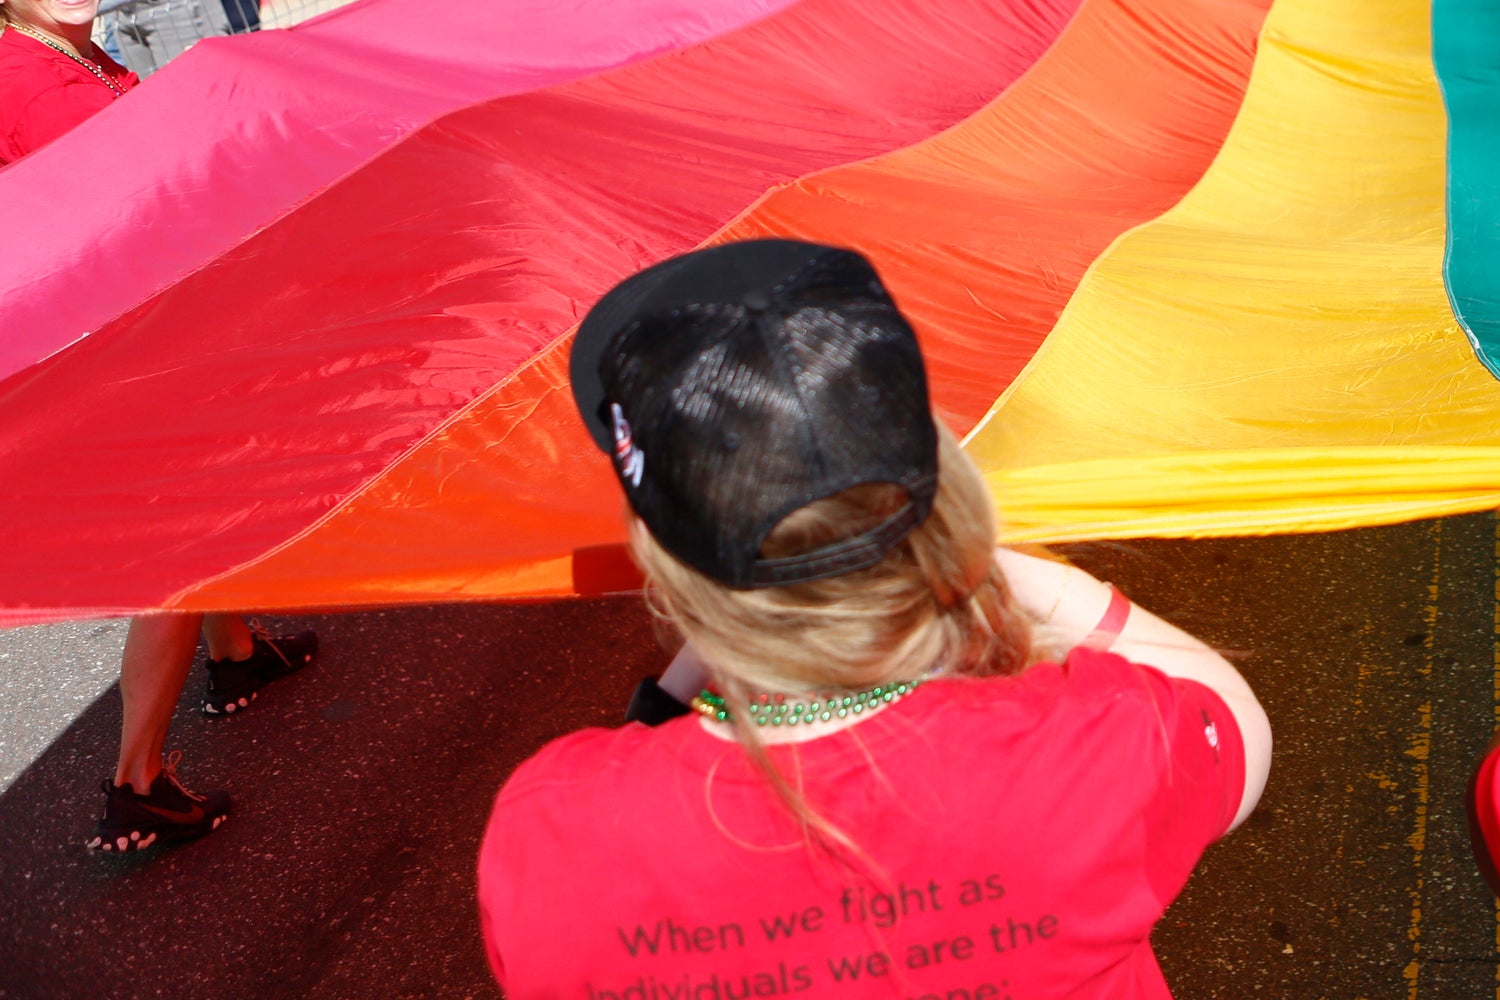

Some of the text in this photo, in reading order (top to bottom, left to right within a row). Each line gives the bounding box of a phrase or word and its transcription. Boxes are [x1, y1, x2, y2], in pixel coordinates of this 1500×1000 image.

[617, 873, 1007, 959] When we fight as
[826, 951, 890, 983] we
[906, 932, 976, 969] are
[988, 911, 1062, 954] the
